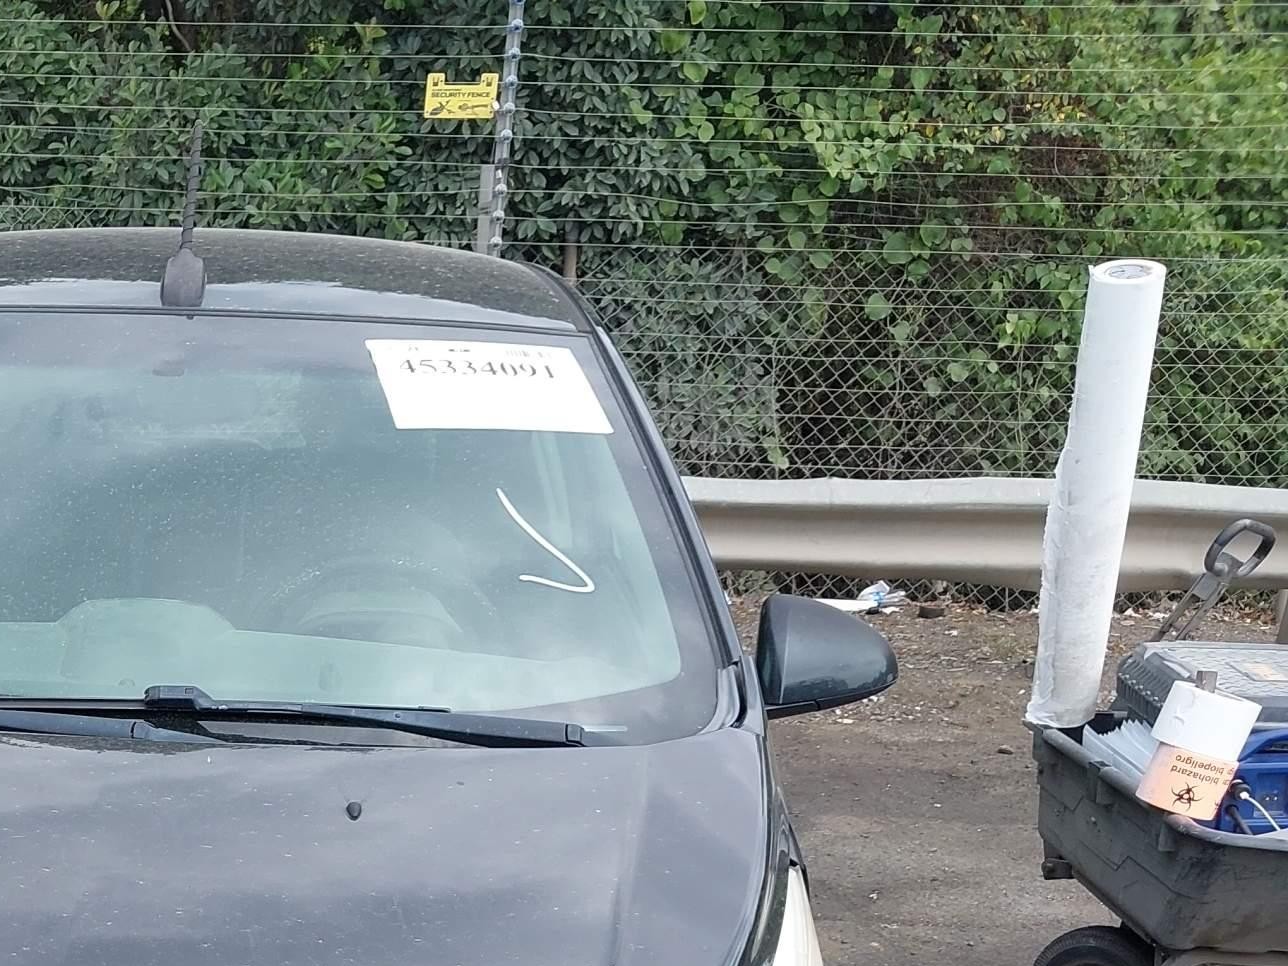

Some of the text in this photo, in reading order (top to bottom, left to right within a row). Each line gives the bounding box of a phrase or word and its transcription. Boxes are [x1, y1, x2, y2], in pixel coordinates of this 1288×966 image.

[400, 359, 555, 379] 45334091
[1175, 754, 1224, 775] biopeligro
[1170, 765, 1219, 785] biohazard
